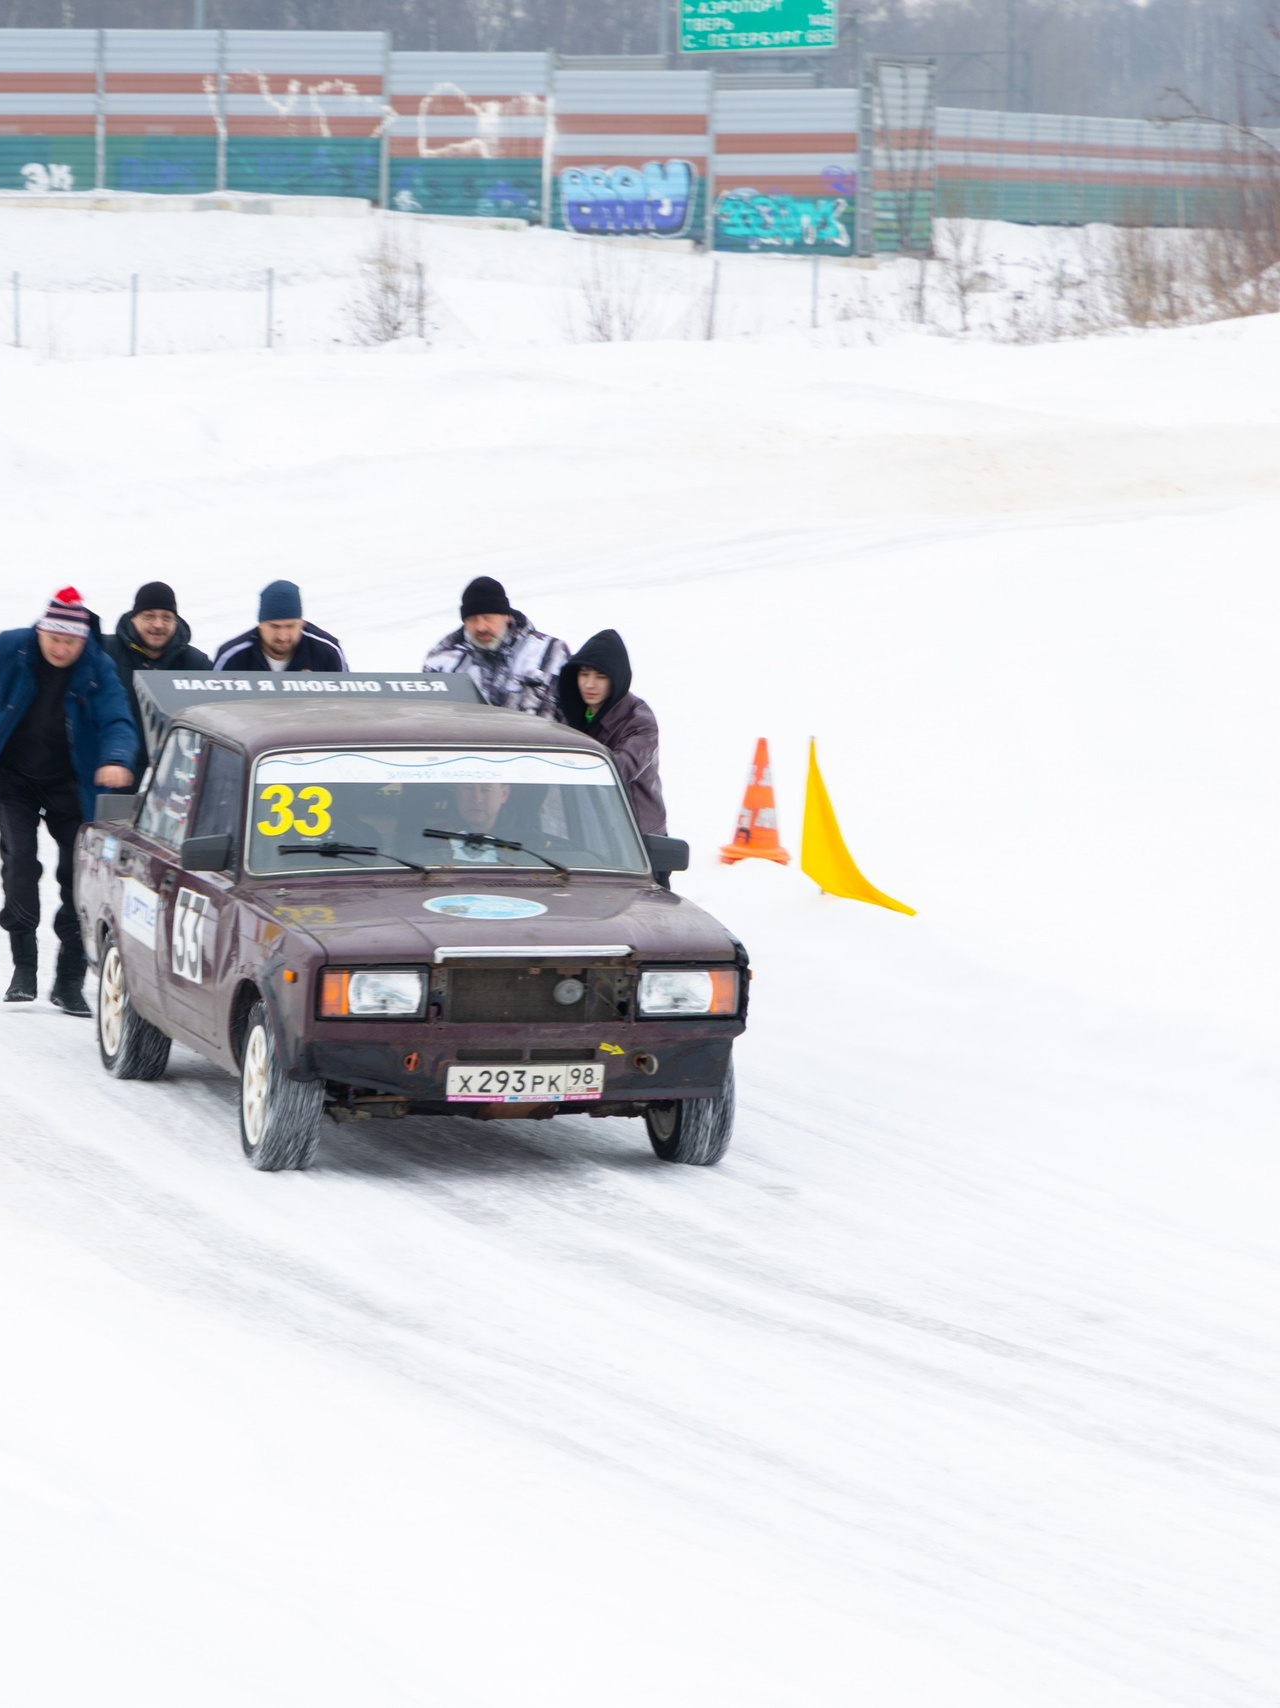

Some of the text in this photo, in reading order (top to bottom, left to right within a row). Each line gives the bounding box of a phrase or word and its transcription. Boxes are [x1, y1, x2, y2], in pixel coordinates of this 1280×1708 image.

[683, 17, 735, 31] ТВЕРЬ
[171, 679, 449, 692] НАСТЯ Я ЛЮБЛЮ ТЕБЯ
[256, 784, 333, 836] 33
[570, 1067, 595, 1085] 98
